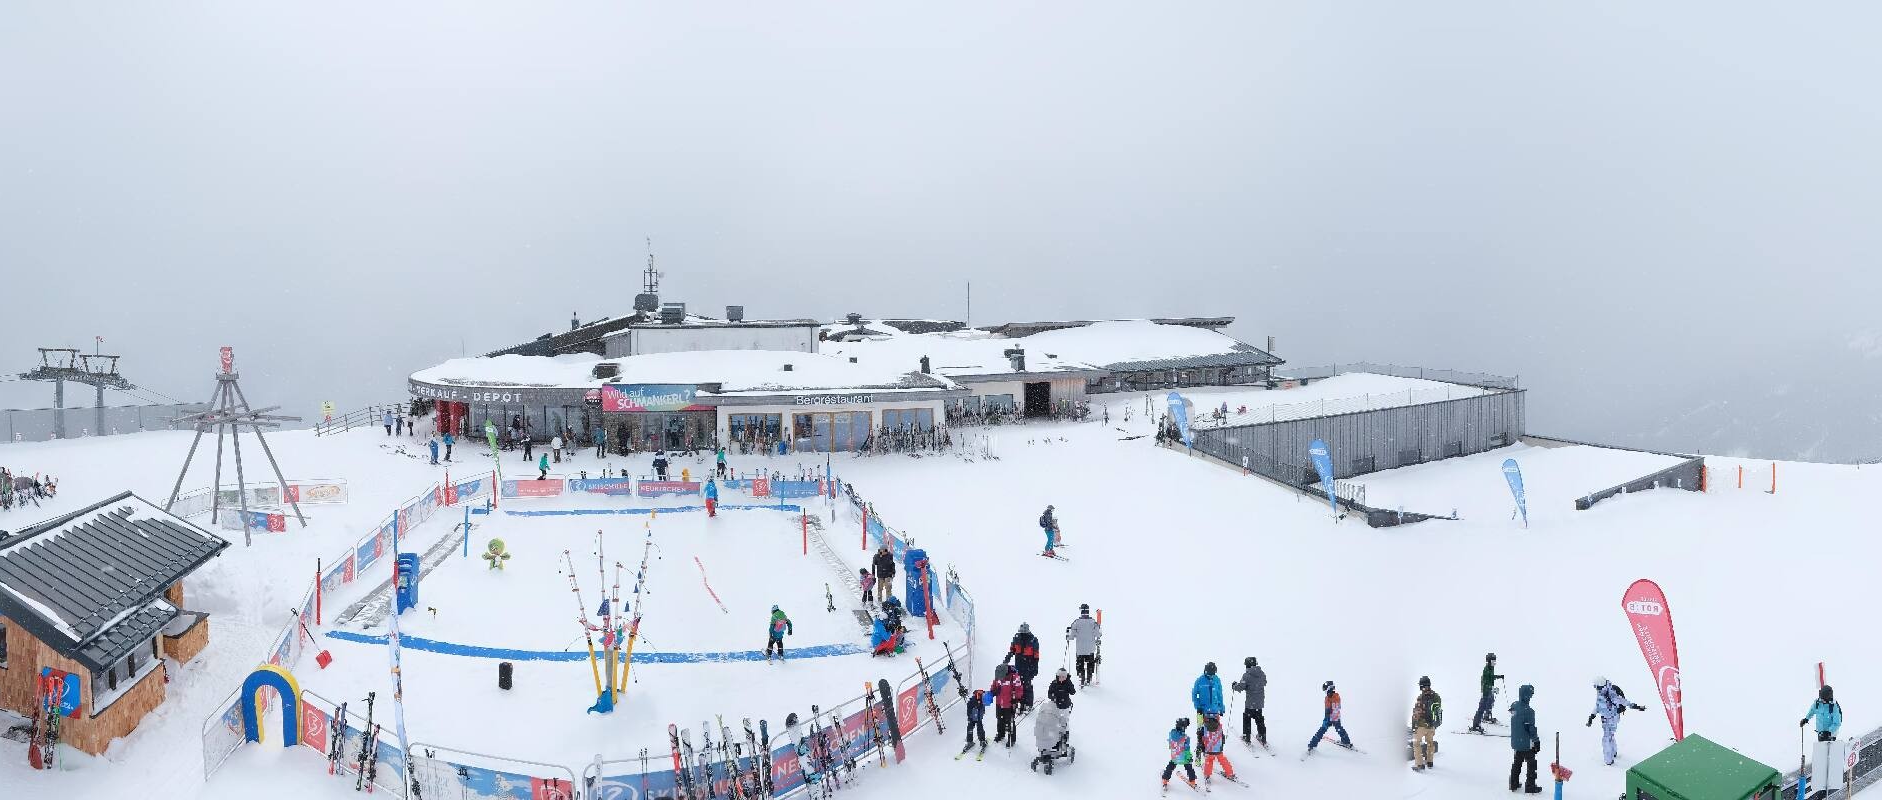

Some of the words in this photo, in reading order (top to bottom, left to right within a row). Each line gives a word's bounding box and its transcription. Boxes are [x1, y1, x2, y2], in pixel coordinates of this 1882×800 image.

[608, 388, 627, 400] Wild
[629, 386, 645, 398] auf
[796, 393, 874, 405] Bergrestaurant
[640, 484, 687, 493] NEUKIRCHEN
